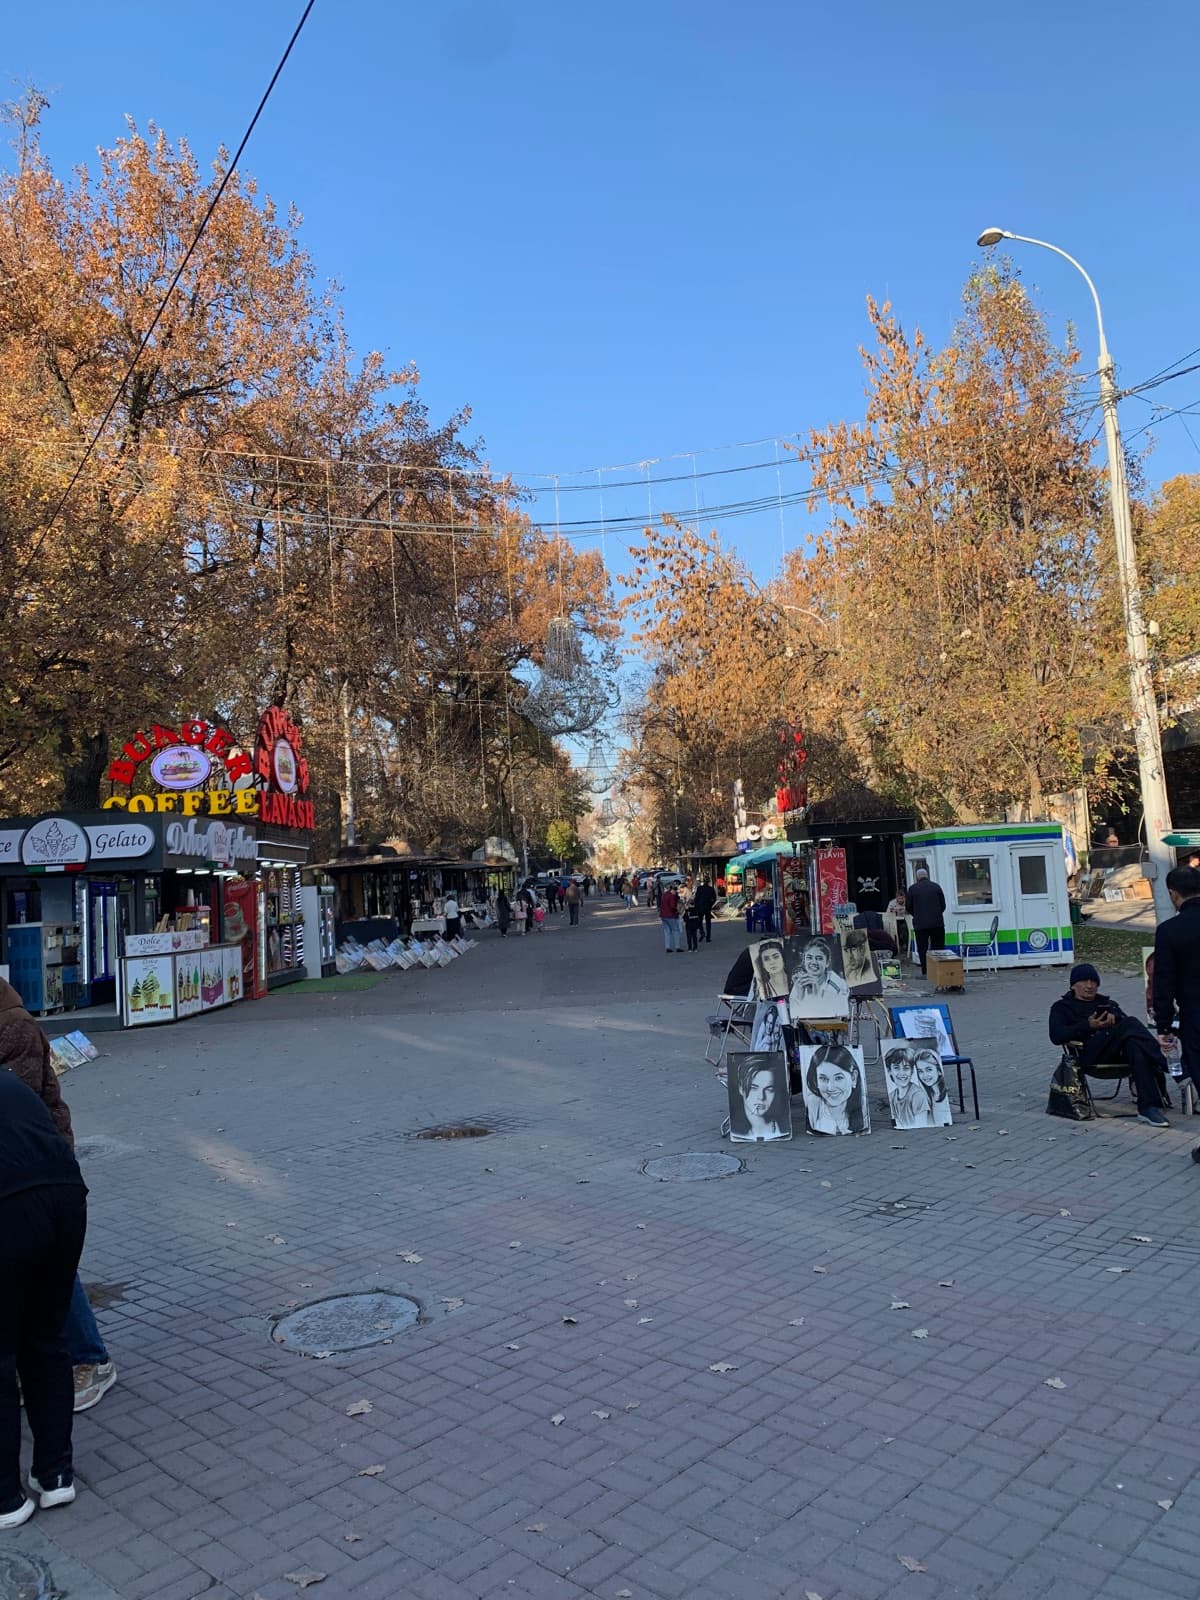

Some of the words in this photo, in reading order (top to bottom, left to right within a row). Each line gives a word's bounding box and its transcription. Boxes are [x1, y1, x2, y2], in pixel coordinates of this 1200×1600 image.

[103, 787, 260, 816] COFFEE
[259, 790, 315, 830] LAVASH
[95, 830, 147, 853] Gelato
